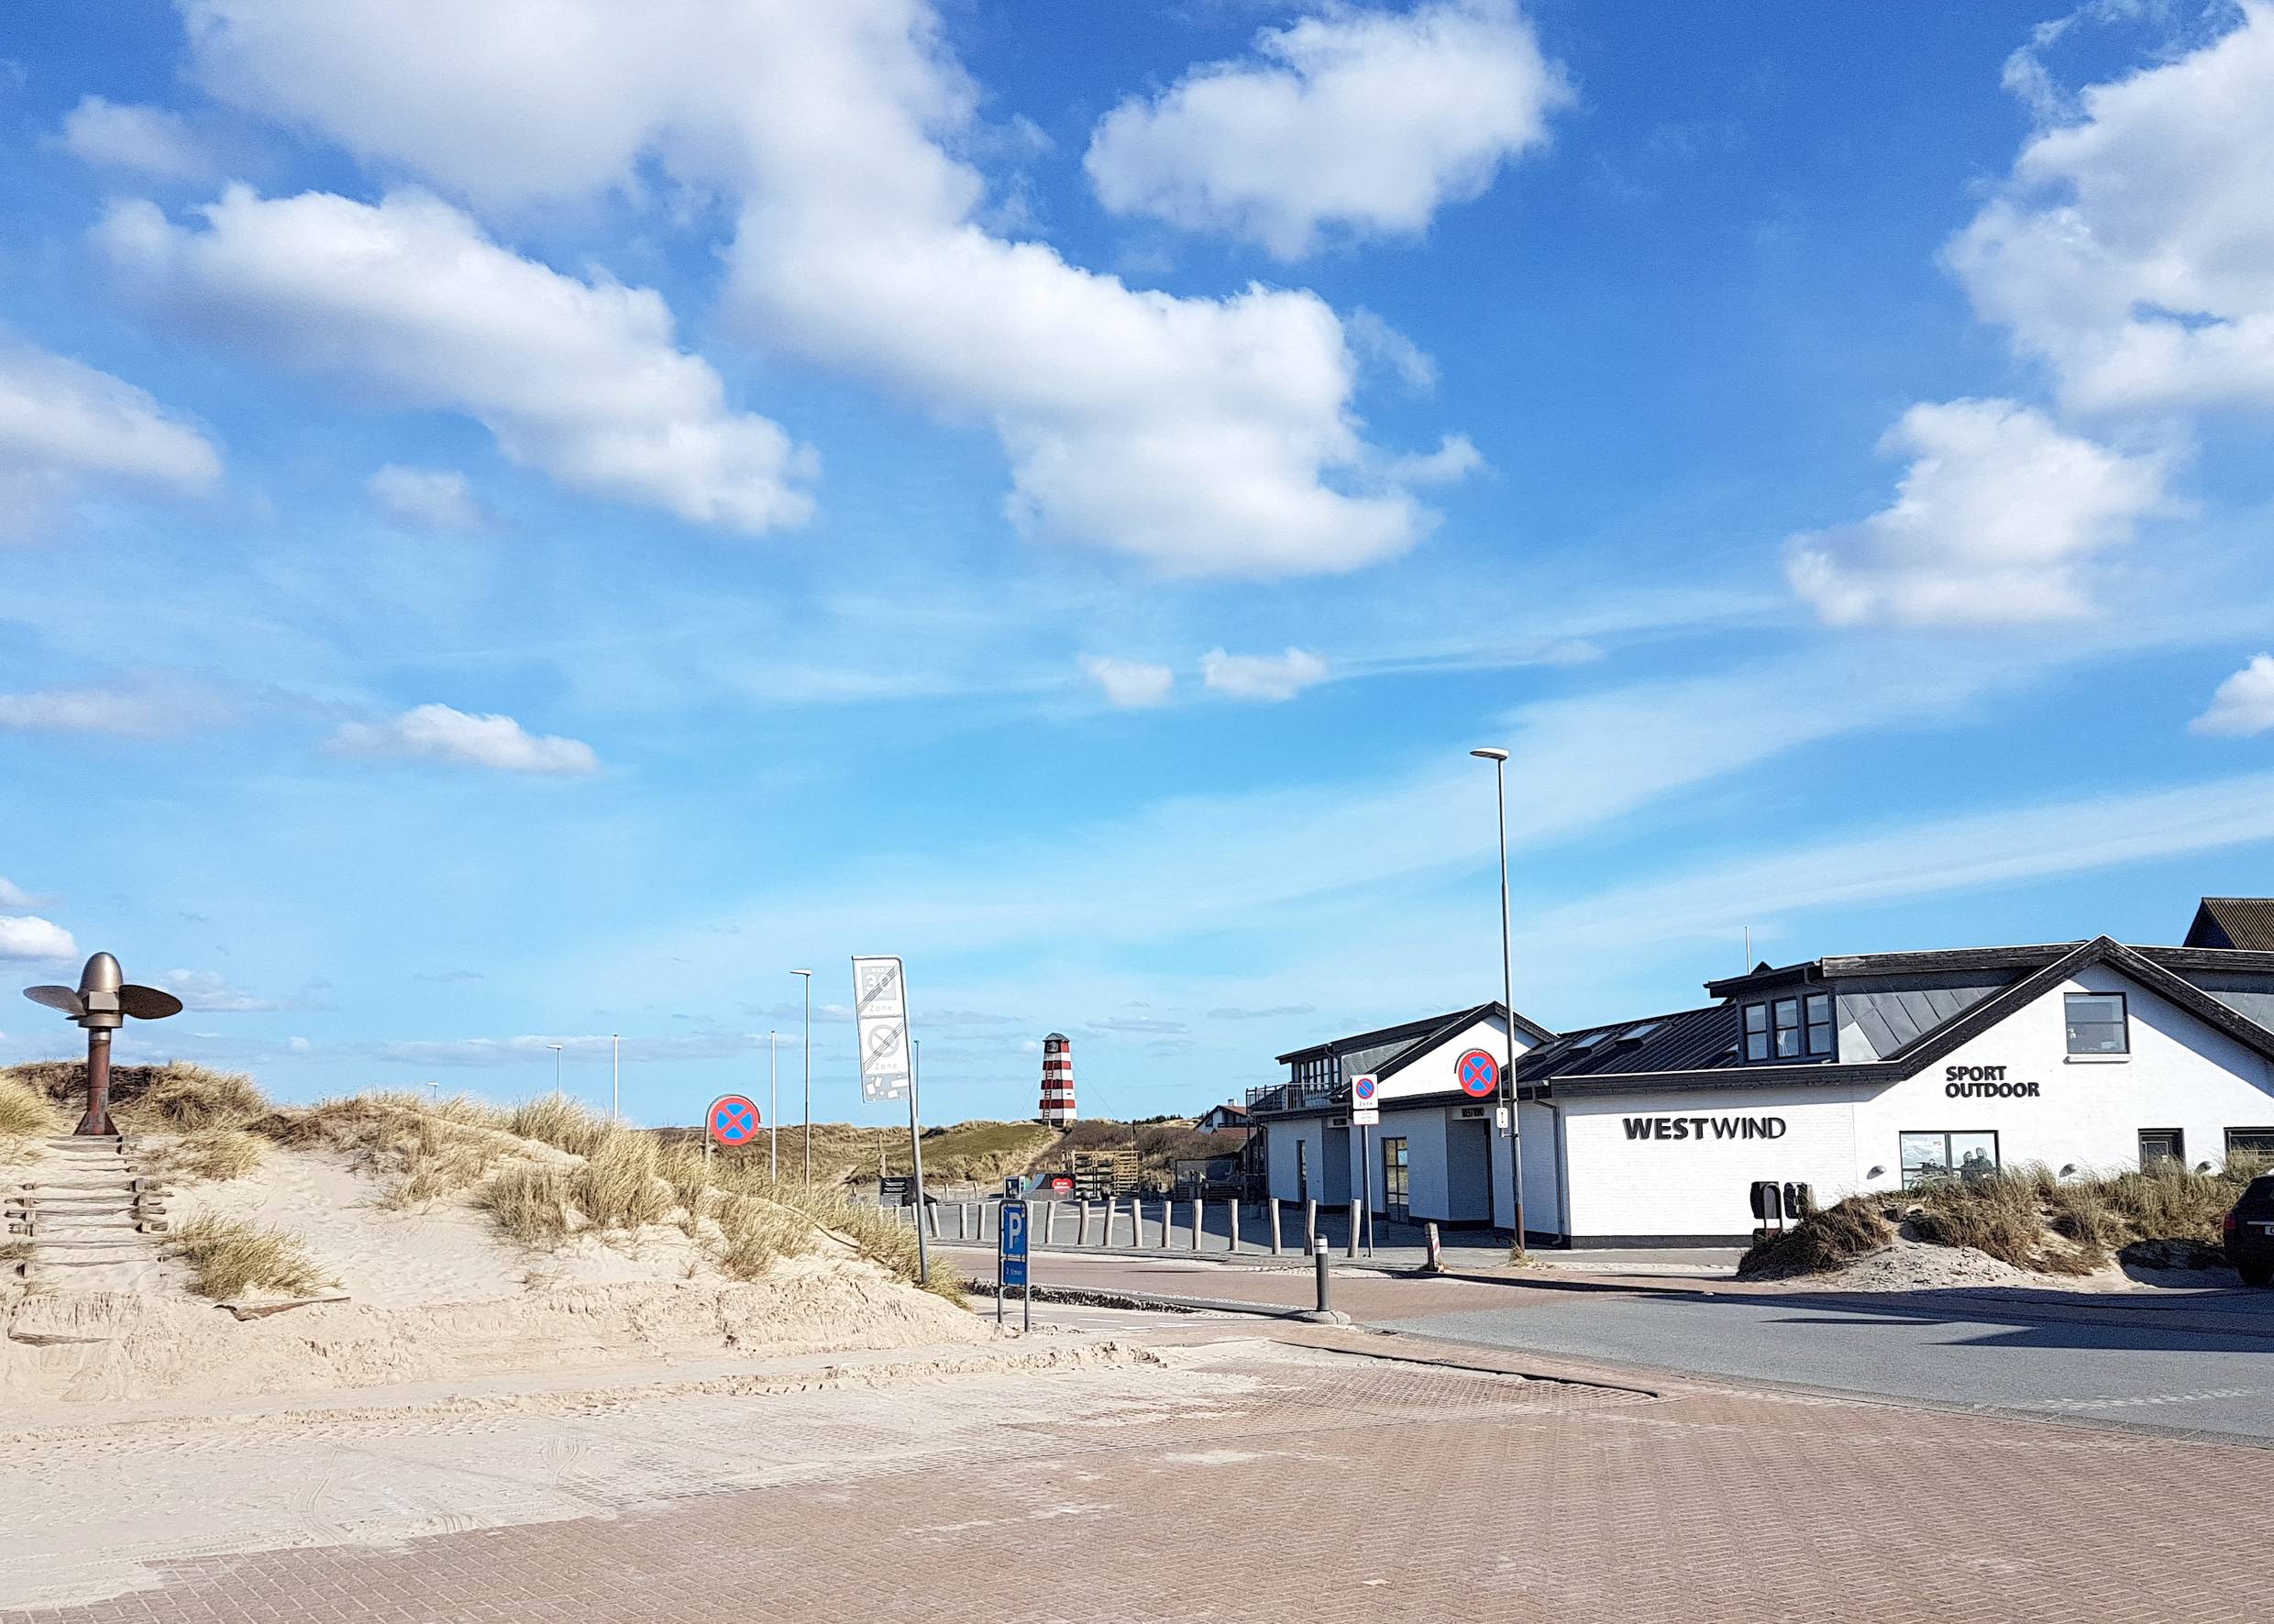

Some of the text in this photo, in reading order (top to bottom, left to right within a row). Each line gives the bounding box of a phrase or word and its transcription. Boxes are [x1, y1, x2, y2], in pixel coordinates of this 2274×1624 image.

[869, 1004, 892, 1012] Zone
[1946, 1066, 2007, 1081] SPORT
[1945, 1082, 2041, 1098] OUTDOOR
[1622, 1117, 1787, 1140] WESTWIND
[1009, 1211, 1022, 1249] P
